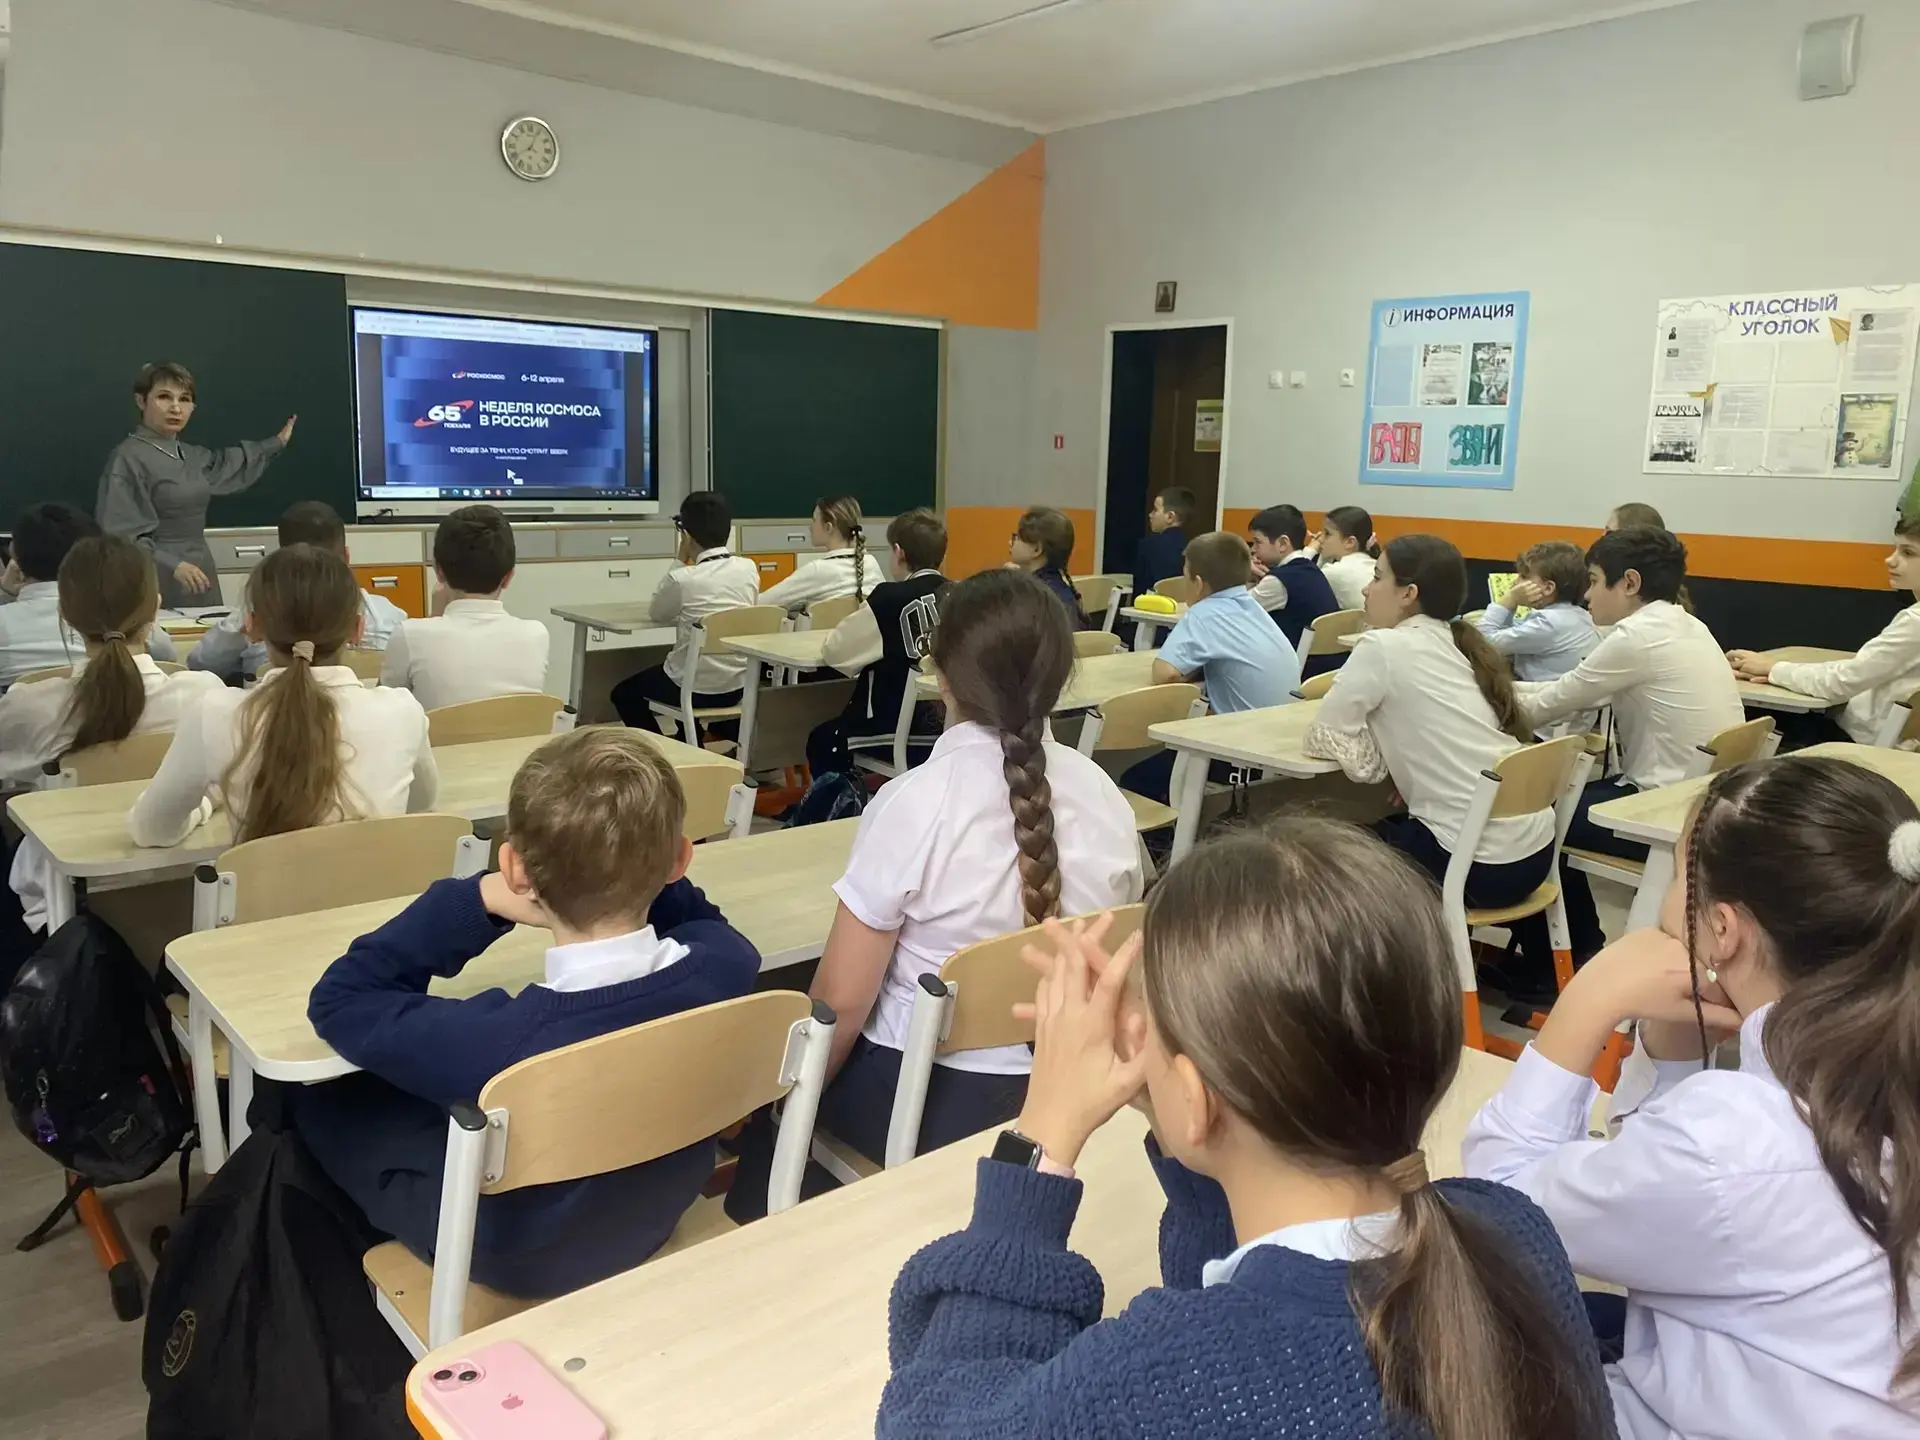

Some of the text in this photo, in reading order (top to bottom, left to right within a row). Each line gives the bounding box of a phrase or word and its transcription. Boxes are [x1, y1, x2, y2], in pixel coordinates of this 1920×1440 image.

[1403, 303, 1514, 322] ИНФОРМАЦИЯ
[1729, 293, 1838, 316] КЛАССНЫЙ
[1741, 318, 1820, 336] УГОЛОК
[428, 405, 461, 421] 65
[479, 400, 601, 416] НЕДЕЛЯ КОСМОСА
[480, 415, 549, 428] В РОССИИ
